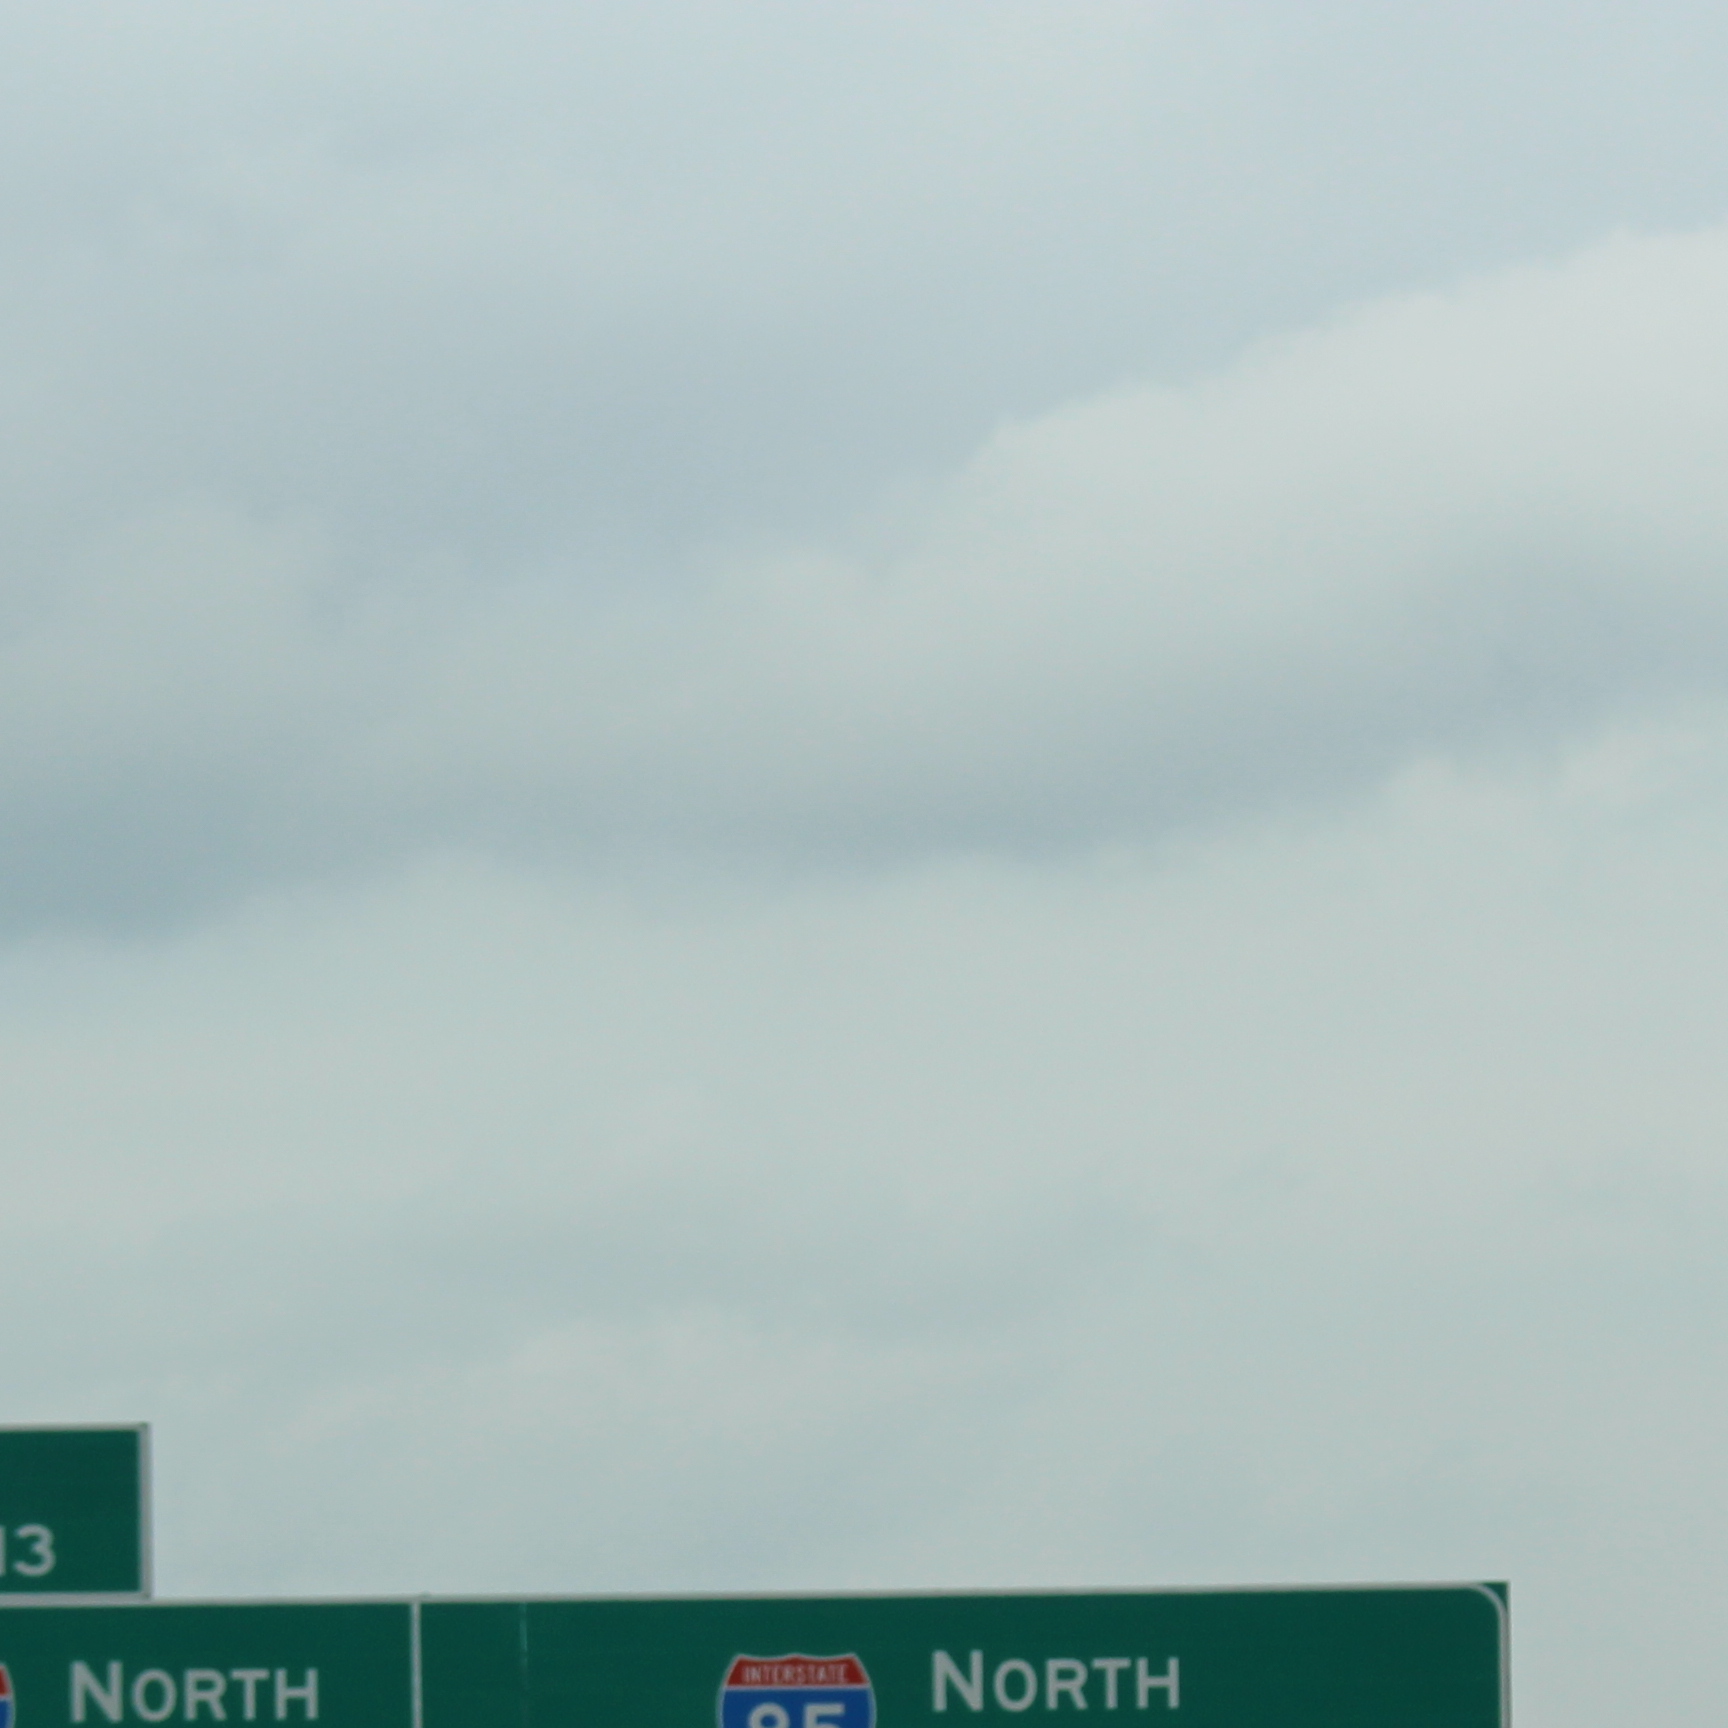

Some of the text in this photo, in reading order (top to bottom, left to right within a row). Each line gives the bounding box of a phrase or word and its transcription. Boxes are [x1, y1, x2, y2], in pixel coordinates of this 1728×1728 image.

[71, 1662, 320, 1721] NORTH
[742, 1665, 848, 1684] INTERSTATE
[931, 1651, 1181, 1712] NORTH
